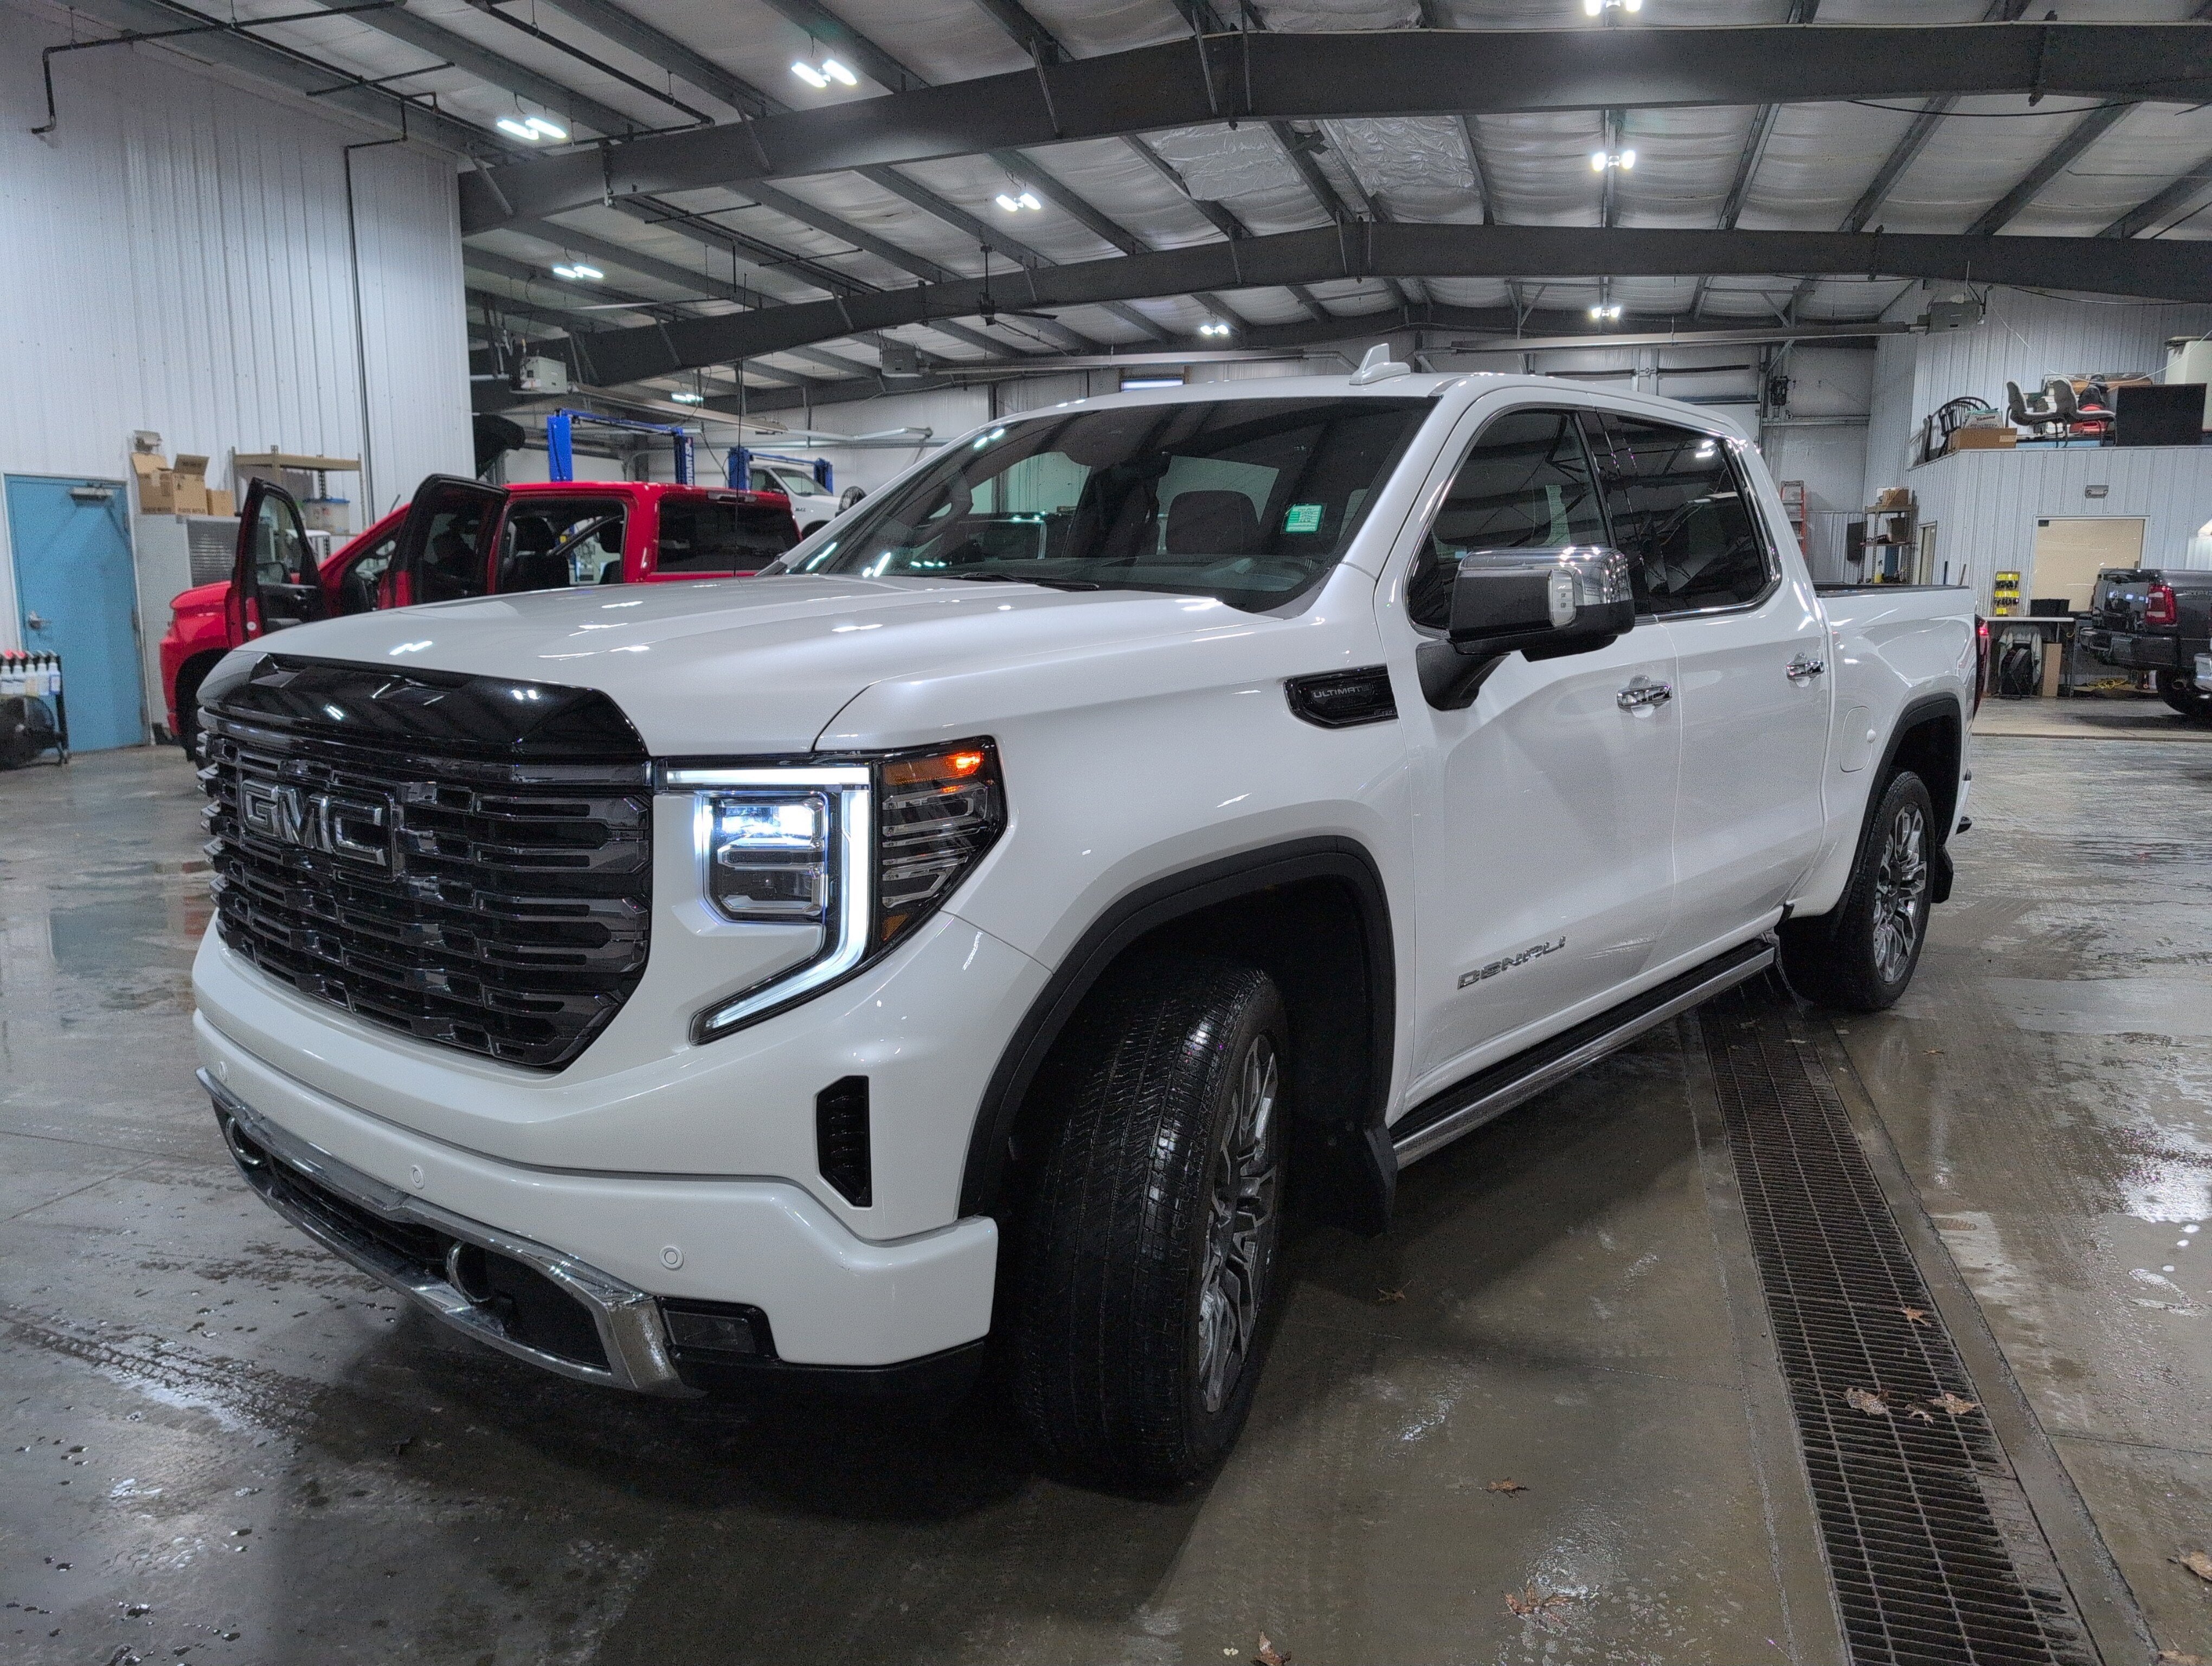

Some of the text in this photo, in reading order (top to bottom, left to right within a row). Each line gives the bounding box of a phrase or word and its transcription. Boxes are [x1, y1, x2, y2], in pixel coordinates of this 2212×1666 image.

[1313, 685, 1370, 698] ULTIMATE
[241, 779, 387, 867] GMC
[1457, 934, 1566, 990] DENALI
